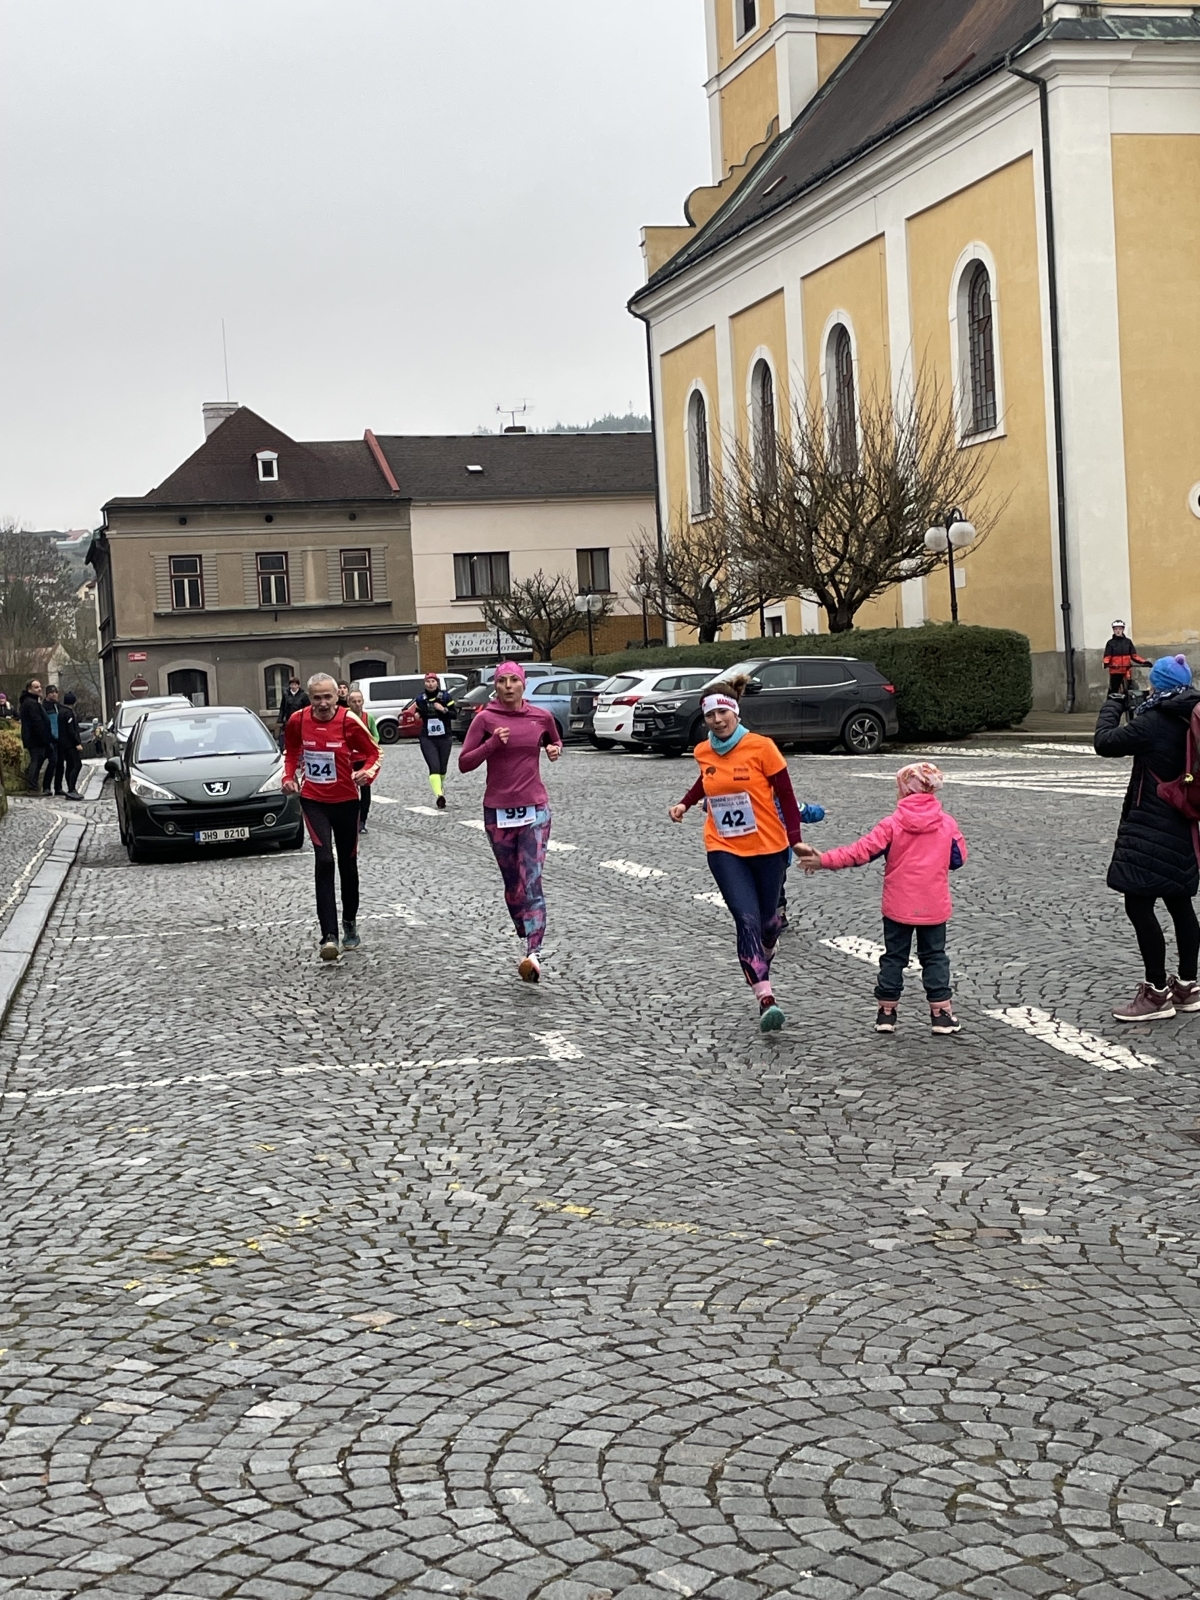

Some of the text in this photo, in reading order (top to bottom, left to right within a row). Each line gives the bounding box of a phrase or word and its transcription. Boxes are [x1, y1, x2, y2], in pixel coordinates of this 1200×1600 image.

[450, 638, 474, 647] SKLO
[306, 762, 332, 777] 124
[505, 806, 527, 820] 99
[721, 809, 747, 828] 42
[201, 828, 246, 841] 3H9 8210
